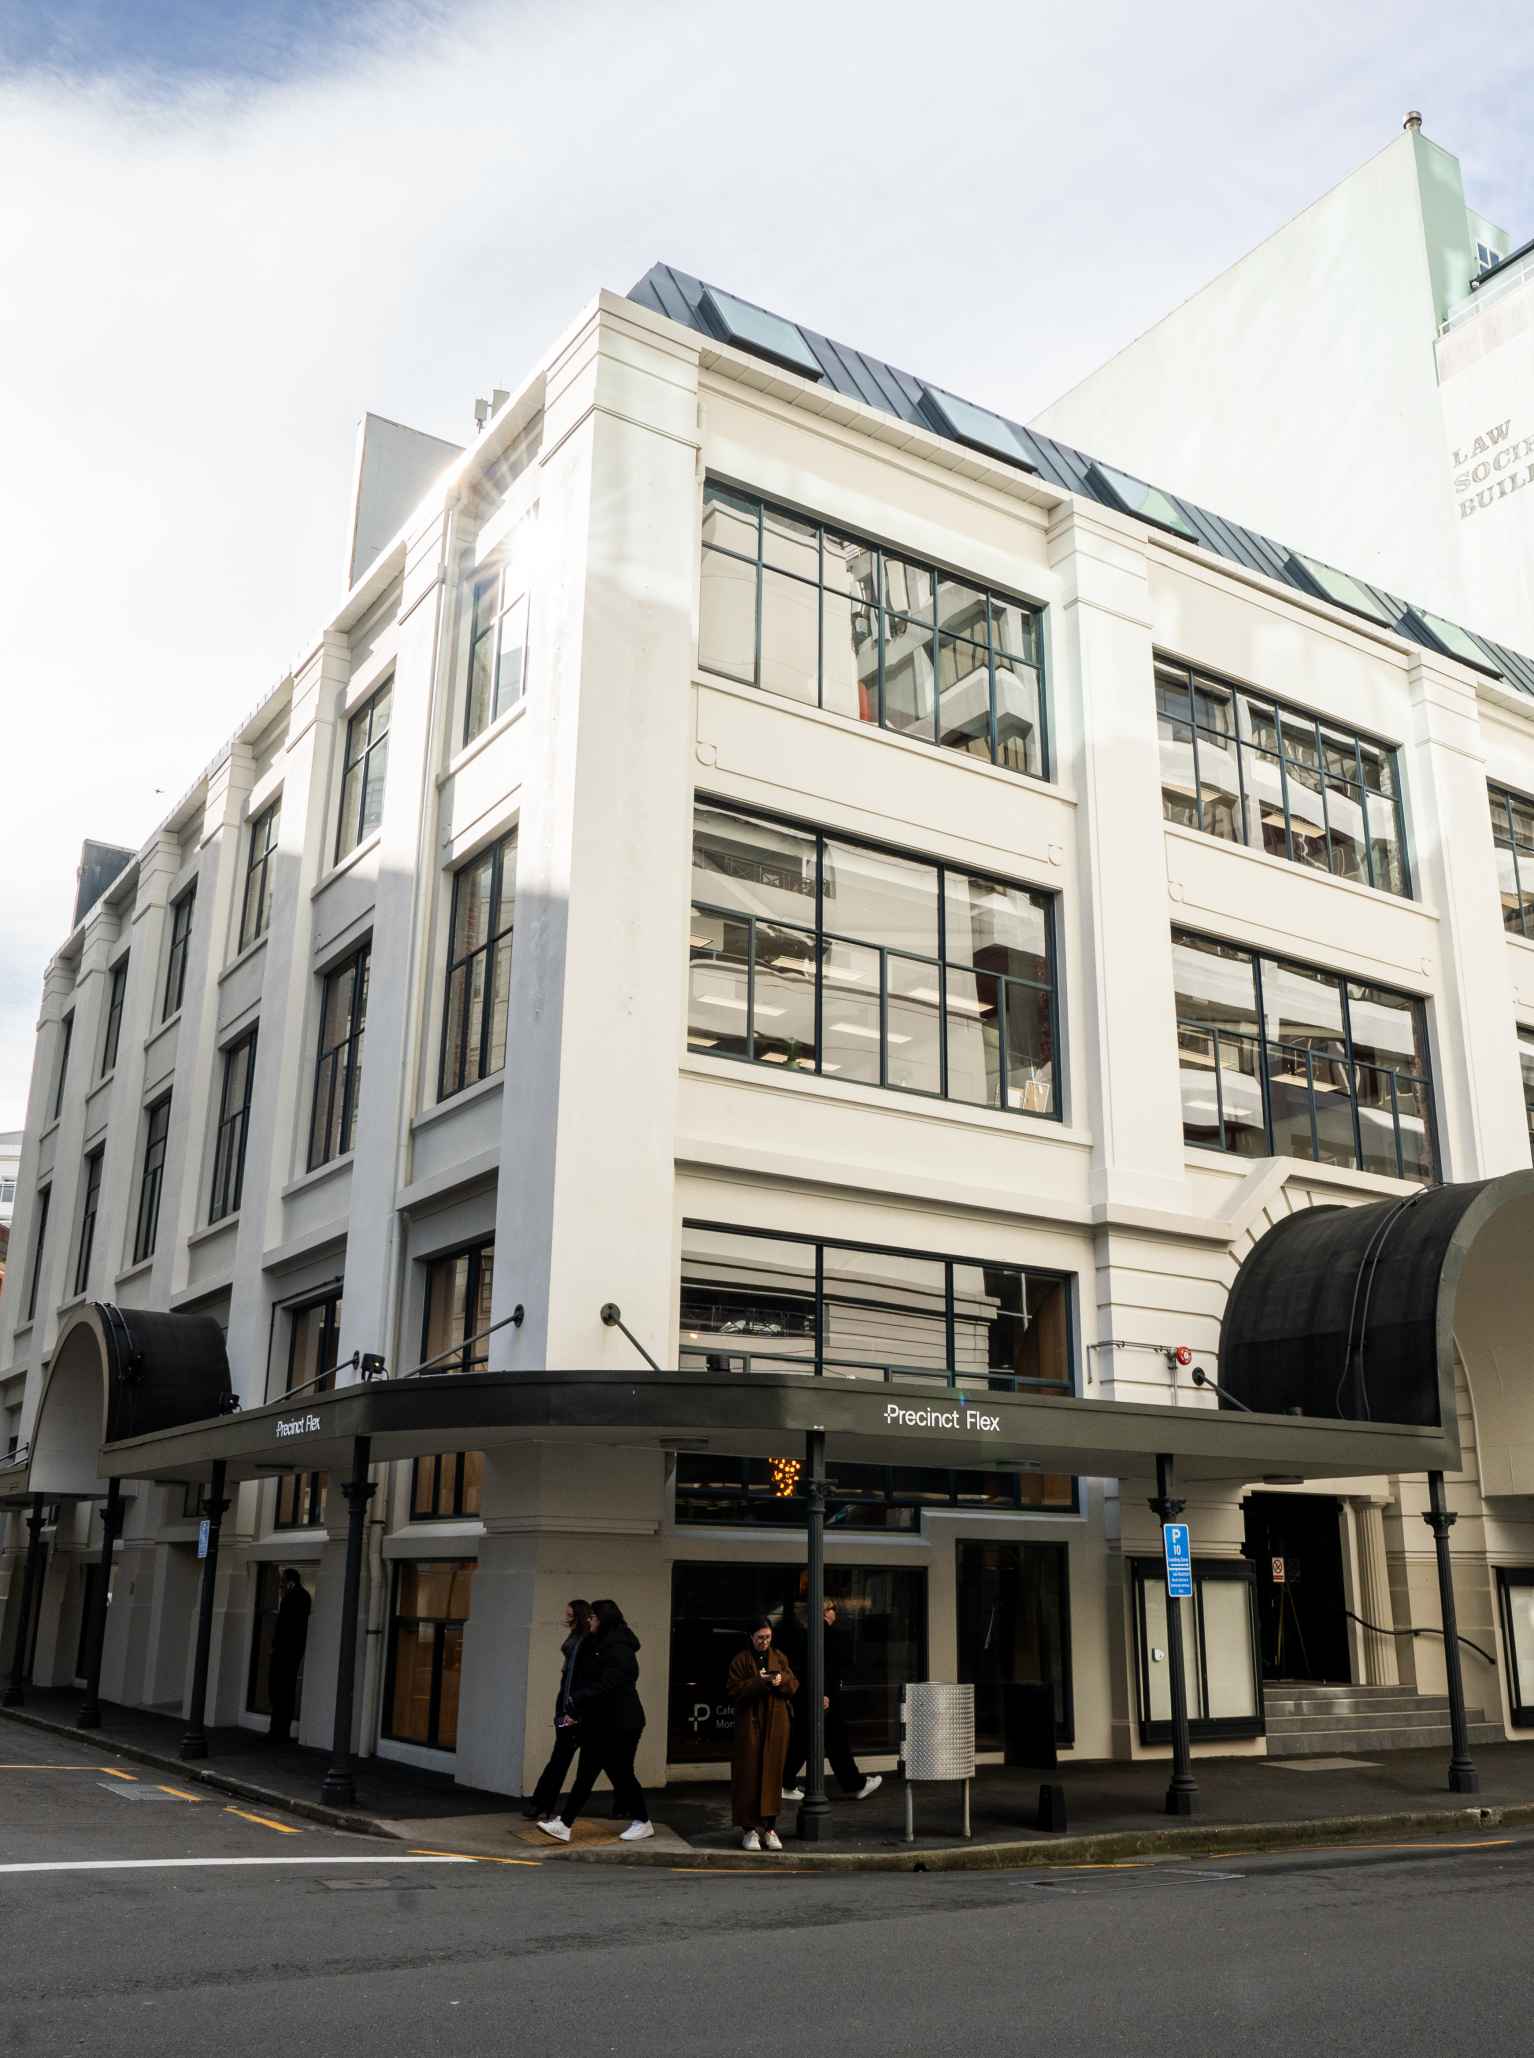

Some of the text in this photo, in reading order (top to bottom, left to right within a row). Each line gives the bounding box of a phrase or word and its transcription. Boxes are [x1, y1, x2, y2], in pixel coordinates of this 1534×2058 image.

[1451, 419, 1511, 469] LAW
[276, 1415, 320, 1437] Precinct Flex
[884, 1404, 1000, 1431] Precinct Flex
[1172, 1528, 1181, 1543] P
[1173, 1545, 1181, 1555] 10
